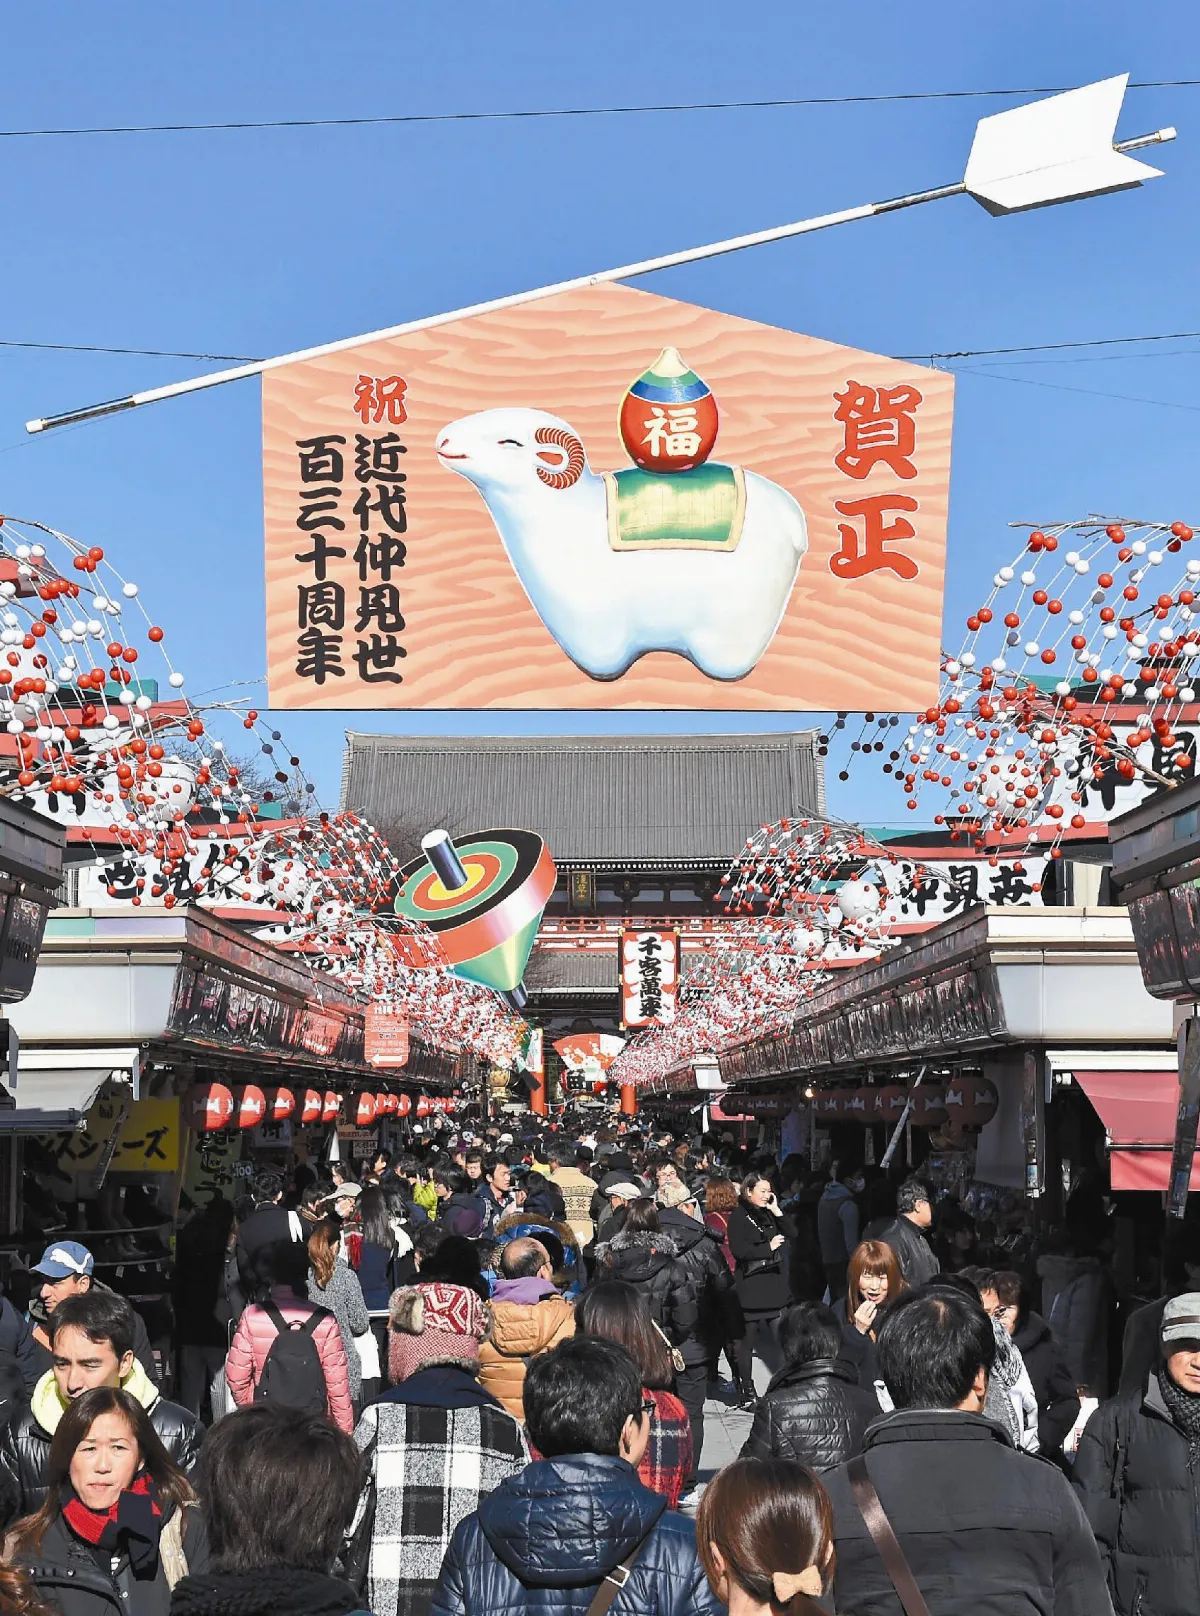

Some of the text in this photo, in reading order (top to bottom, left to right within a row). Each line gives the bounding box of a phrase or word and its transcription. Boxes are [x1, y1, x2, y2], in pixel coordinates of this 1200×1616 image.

[353, 375, 408, 685] 祝 近代仲見世
[641, 406, 702, 457] 福
[830, 379, 922, 580] 賀正
[295, 434, 346, 685] 百三十周年
